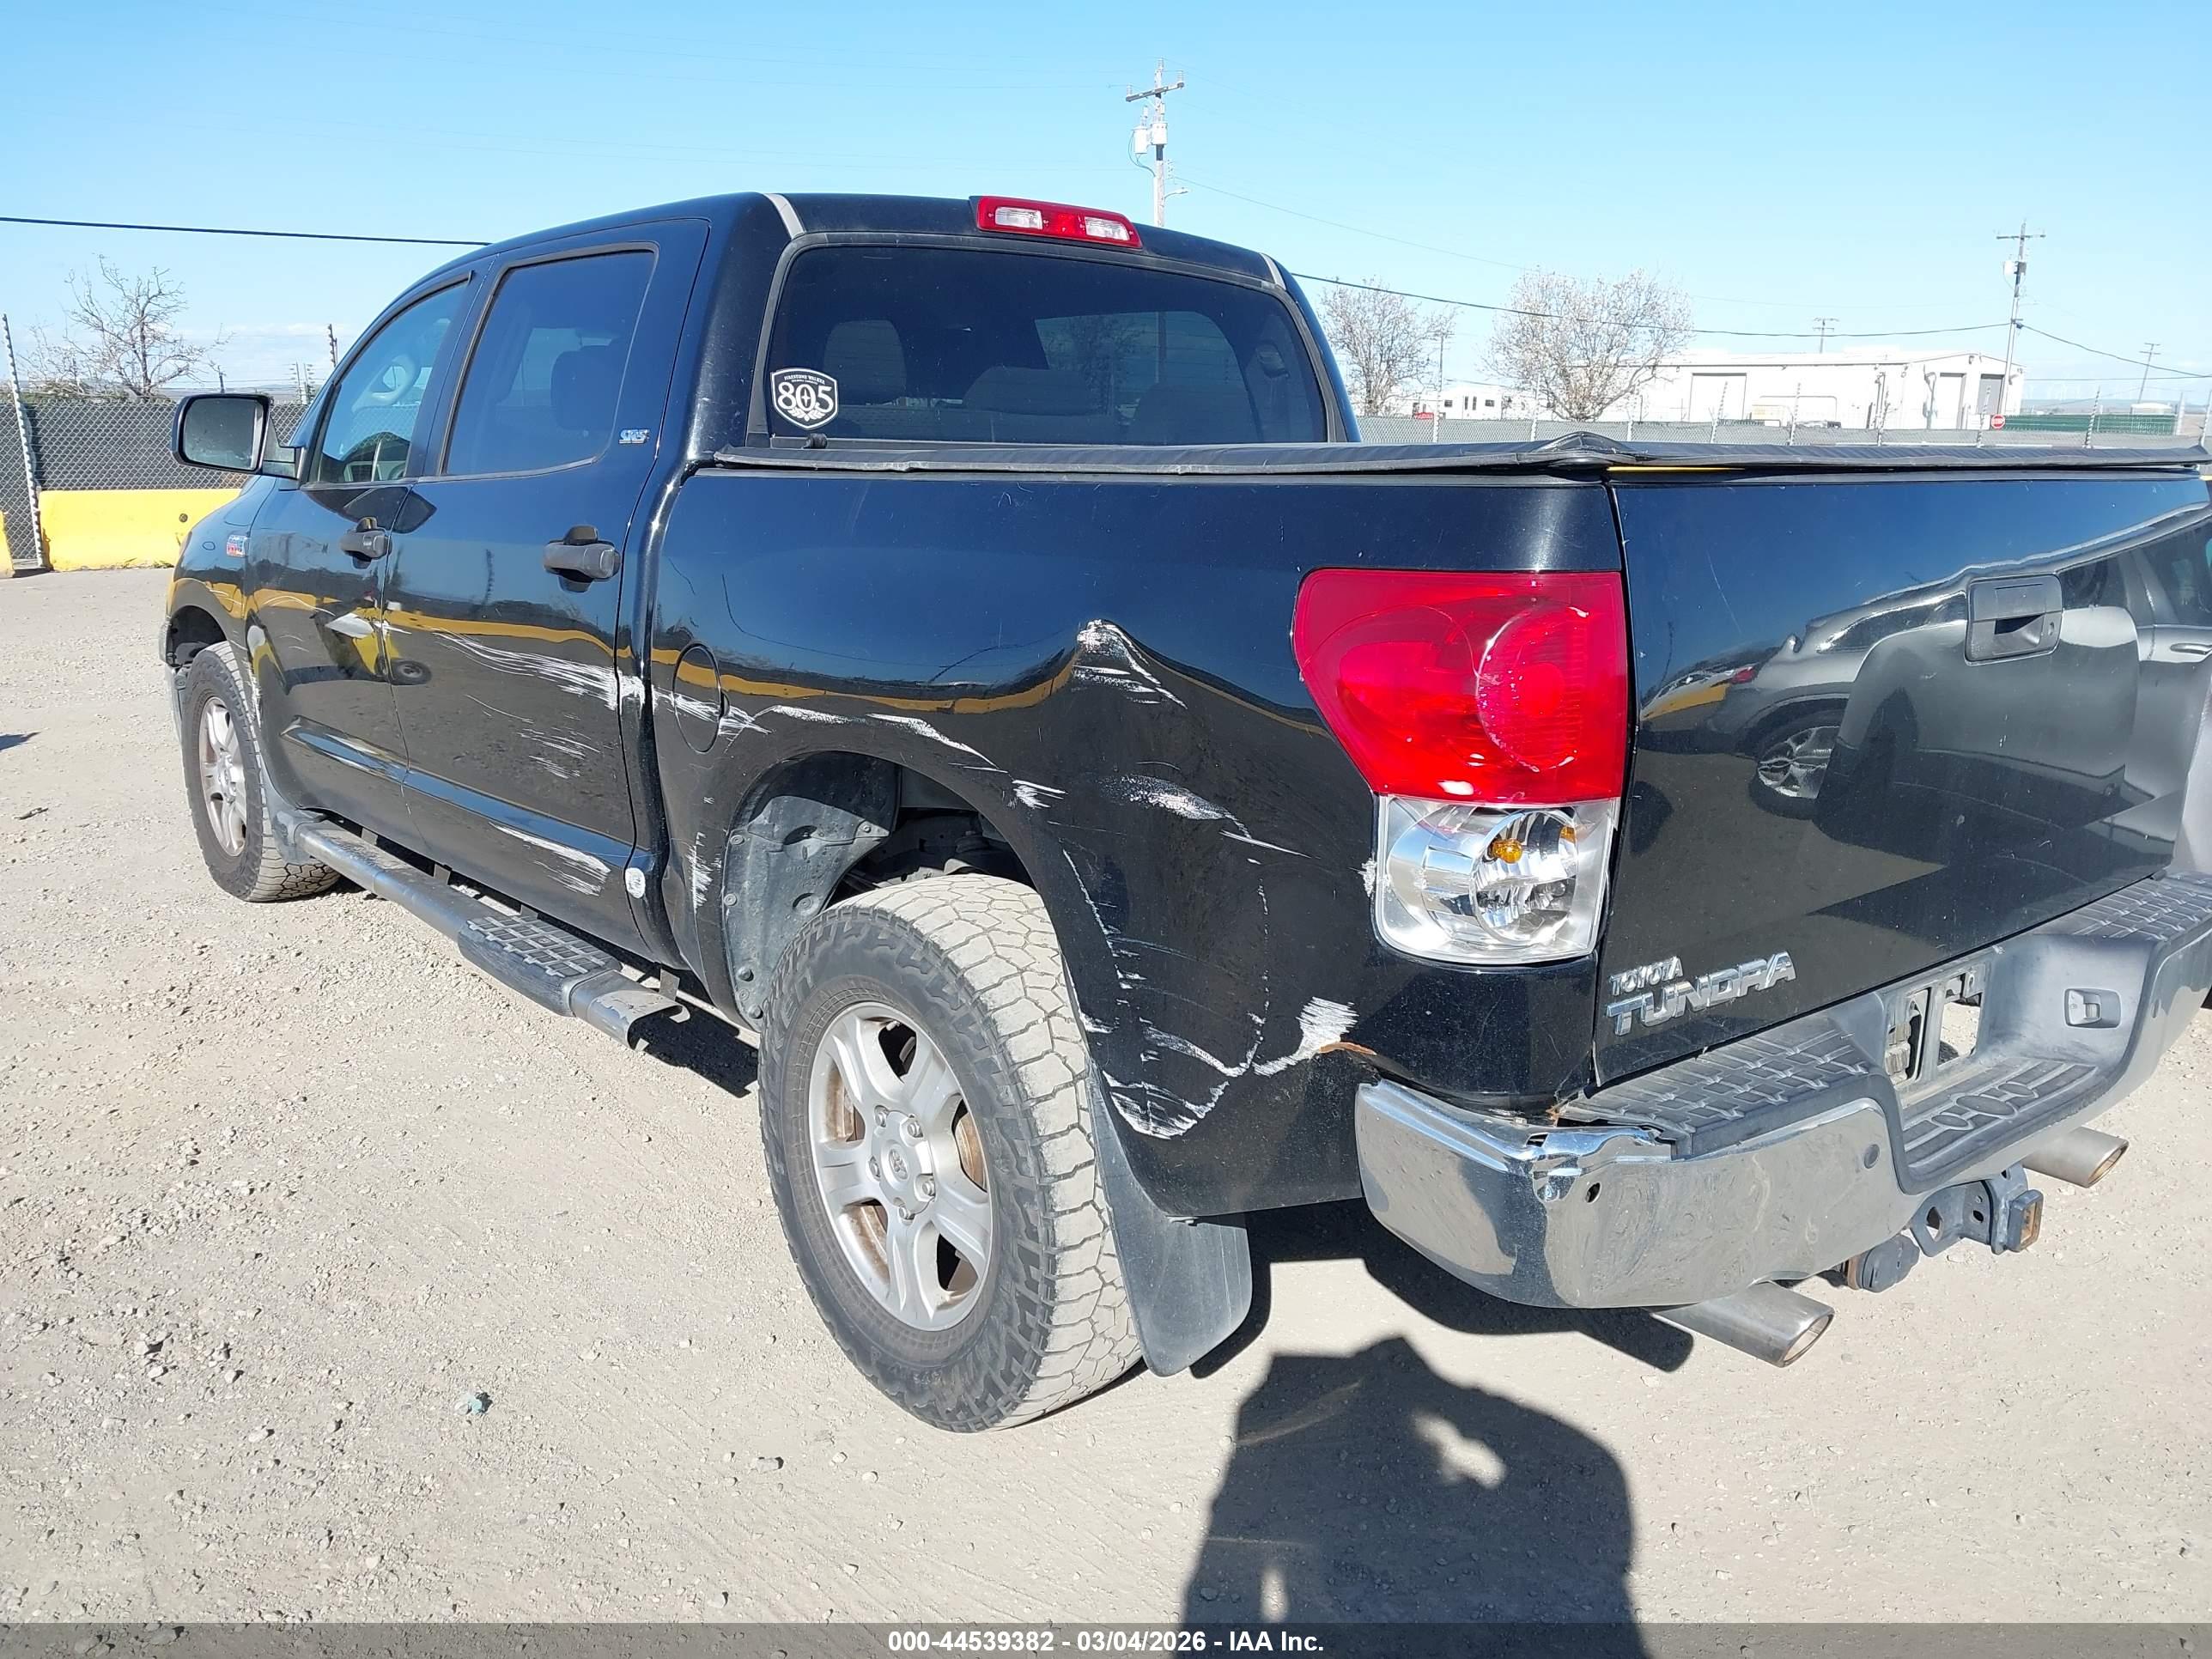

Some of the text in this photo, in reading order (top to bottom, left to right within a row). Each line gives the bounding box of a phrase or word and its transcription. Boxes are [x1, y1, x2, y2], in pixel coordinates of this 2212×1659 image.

[778, 382, 834, 413] 805
[1606, 950, 1796, 1036] TUNDRA
[1608, 955, 1684, 996] TOYOTA
